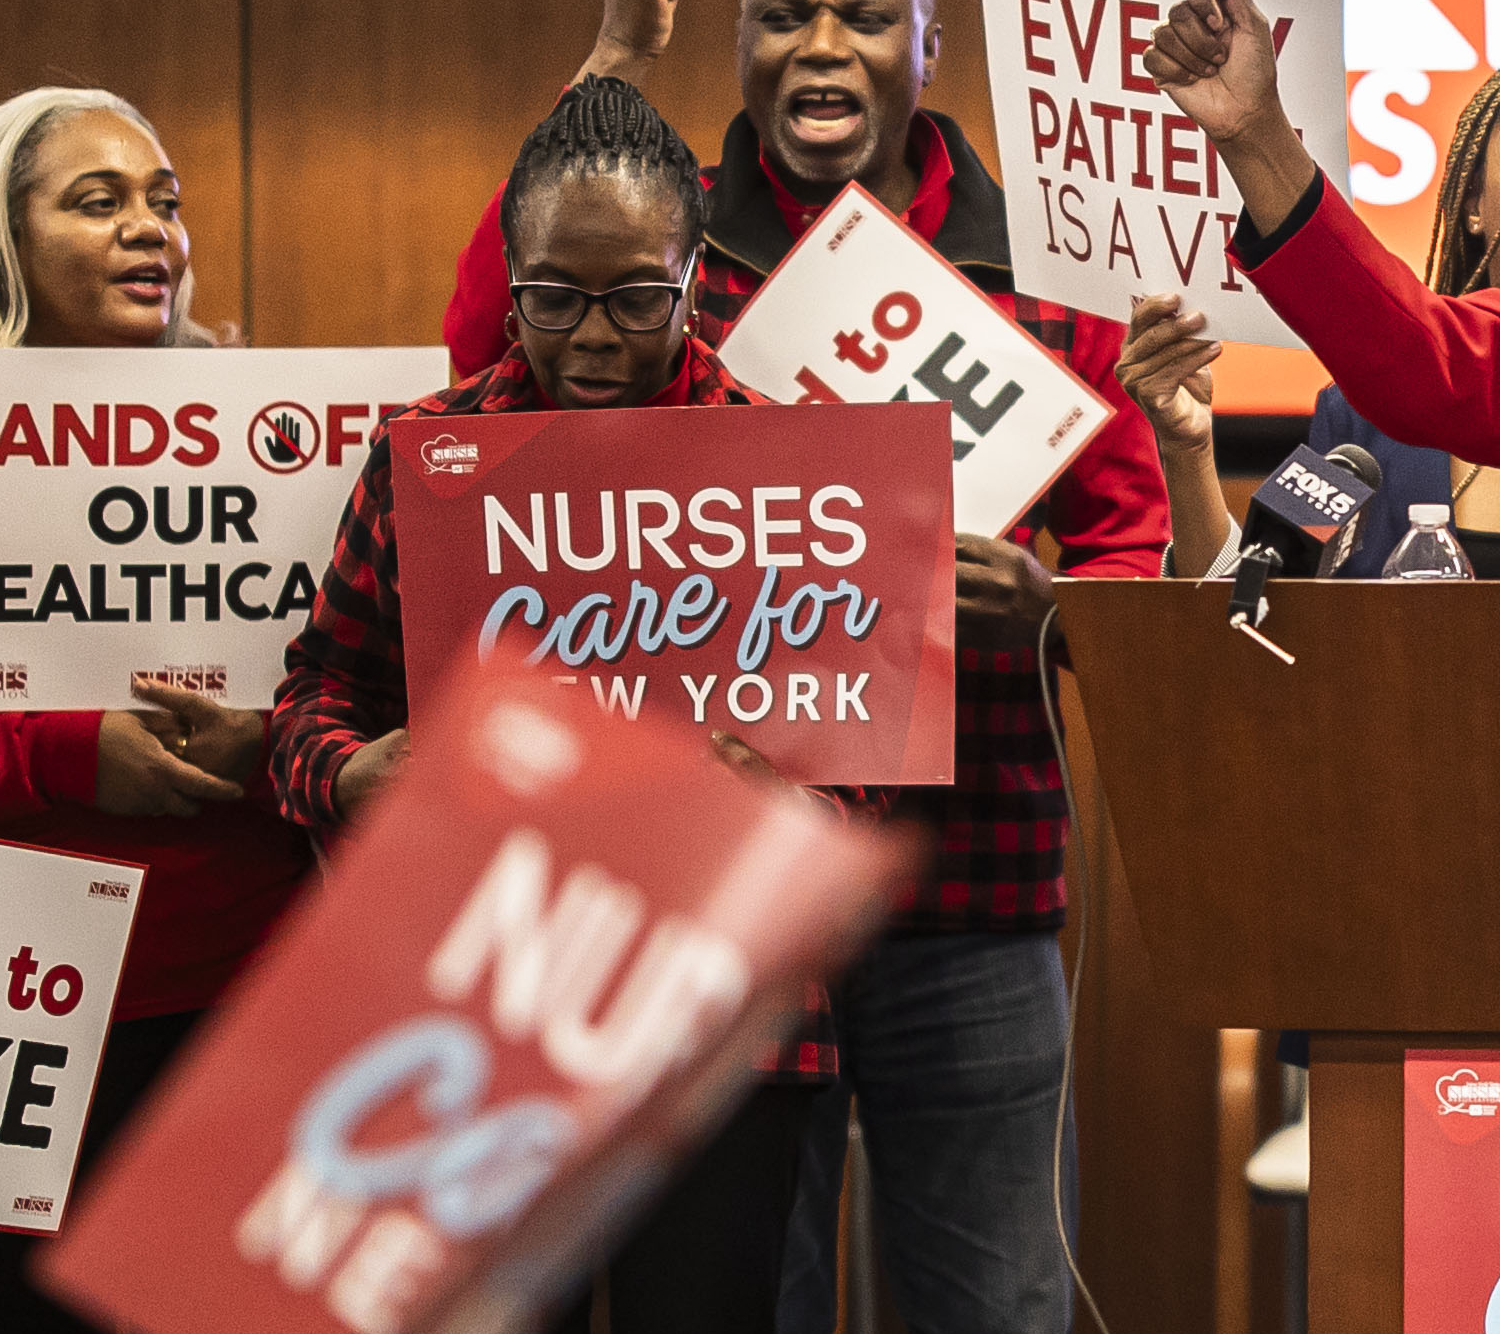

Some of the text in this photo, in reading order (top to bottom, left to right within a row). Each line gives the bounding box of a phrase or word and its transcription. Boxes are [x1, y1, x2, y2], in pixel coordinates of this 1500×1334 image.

[1031, 87, 1304, 197] PATIE
[1042, 178, 1143, 279] IS A
[833, 291, 922, 374] to
[87, 484, 258, 545] OUR
[483, 484, 867, 574] NURSES
[478, 564, 881, 673] Care for
[682, 672, 871, 723] YORK
[7, 946, 84, 1016] to
